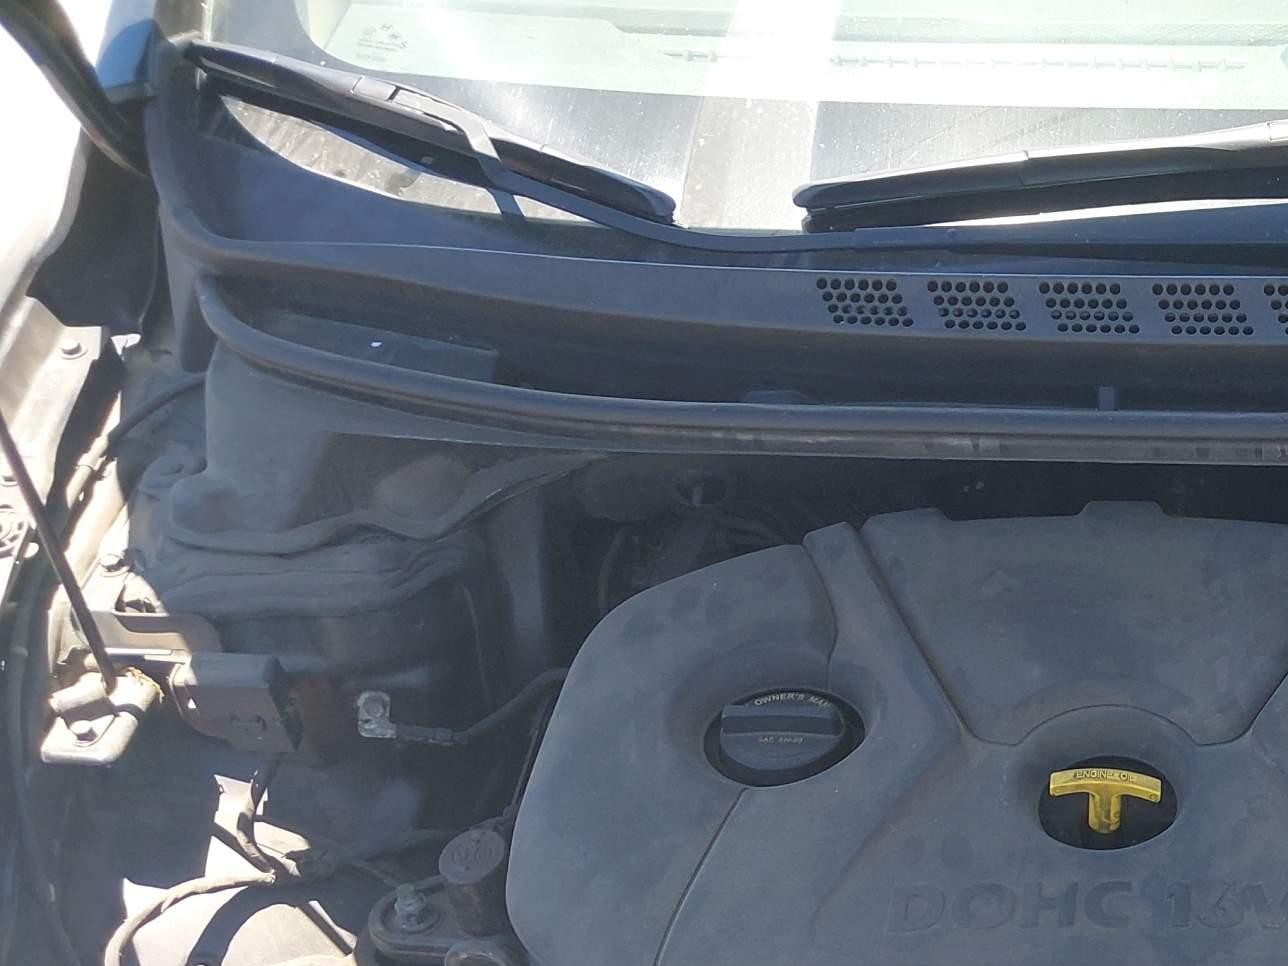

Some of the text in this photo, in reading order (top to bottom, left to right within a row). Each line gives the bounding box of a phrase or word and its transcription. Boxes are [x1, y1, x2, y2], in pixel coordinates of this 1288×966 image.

[754, 693, 805, 706] OWNER'S
[1074, 769, 1113, 780] ENGINE
[889, 880, 1133, 932] DOHC
